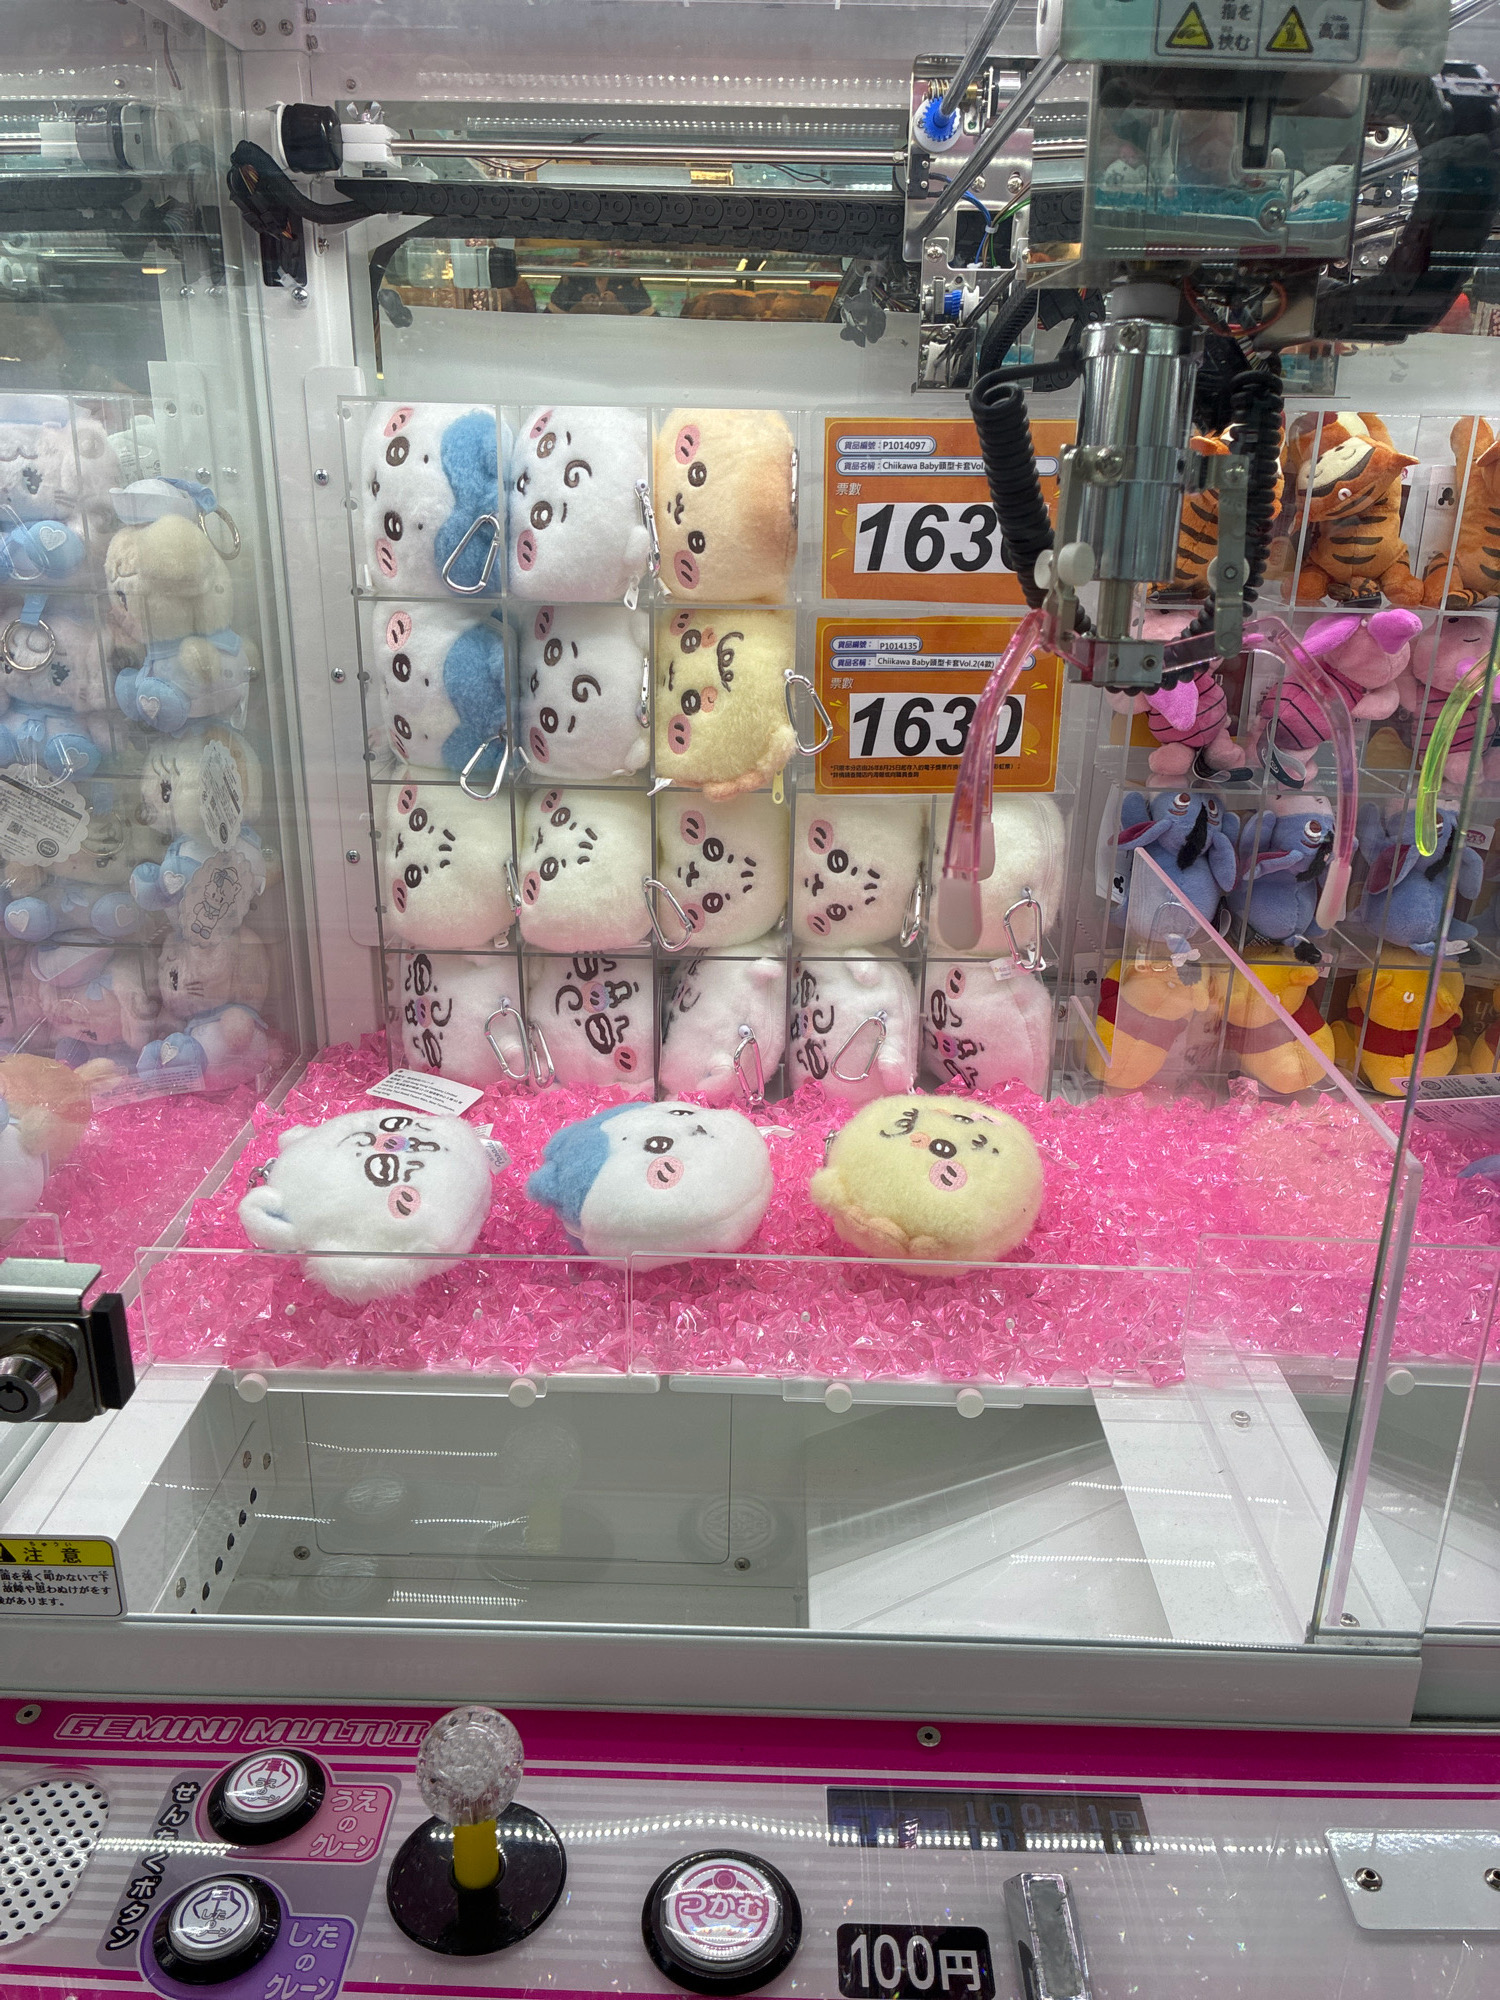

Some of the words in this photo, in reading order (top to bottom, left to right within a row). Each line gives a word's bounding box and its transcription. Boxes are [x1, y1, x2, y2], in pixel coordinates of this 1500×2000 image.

[883, 441, 926, 450] P1014097
[882, 461, 918, 471] Chiikawa
[836, 482, 861, 496] 票數
[859, 504, 1017, 572] 163
[880, 642, 918, 650] P1014135
[878, 657, 911, 667] Chiikawa
[830, 677, 854, 690] 票數
[23, 1547, 82, 1563] 注意
[55, 1714, 242, 1744] GEMINI
[331, 1789, 378, 1813] うえ
[337, 1816, 358, 1833] の
[307, 1833, 376, 1859] クレーン
[680, 1893, 764, 1920] つかむ
[288, 1921, 341, 1950] した
[294, 1953, 317, 1973] の
[850, 1934, 981, 1991] 100円
[264, 1973, 336, 2000] クレーン
